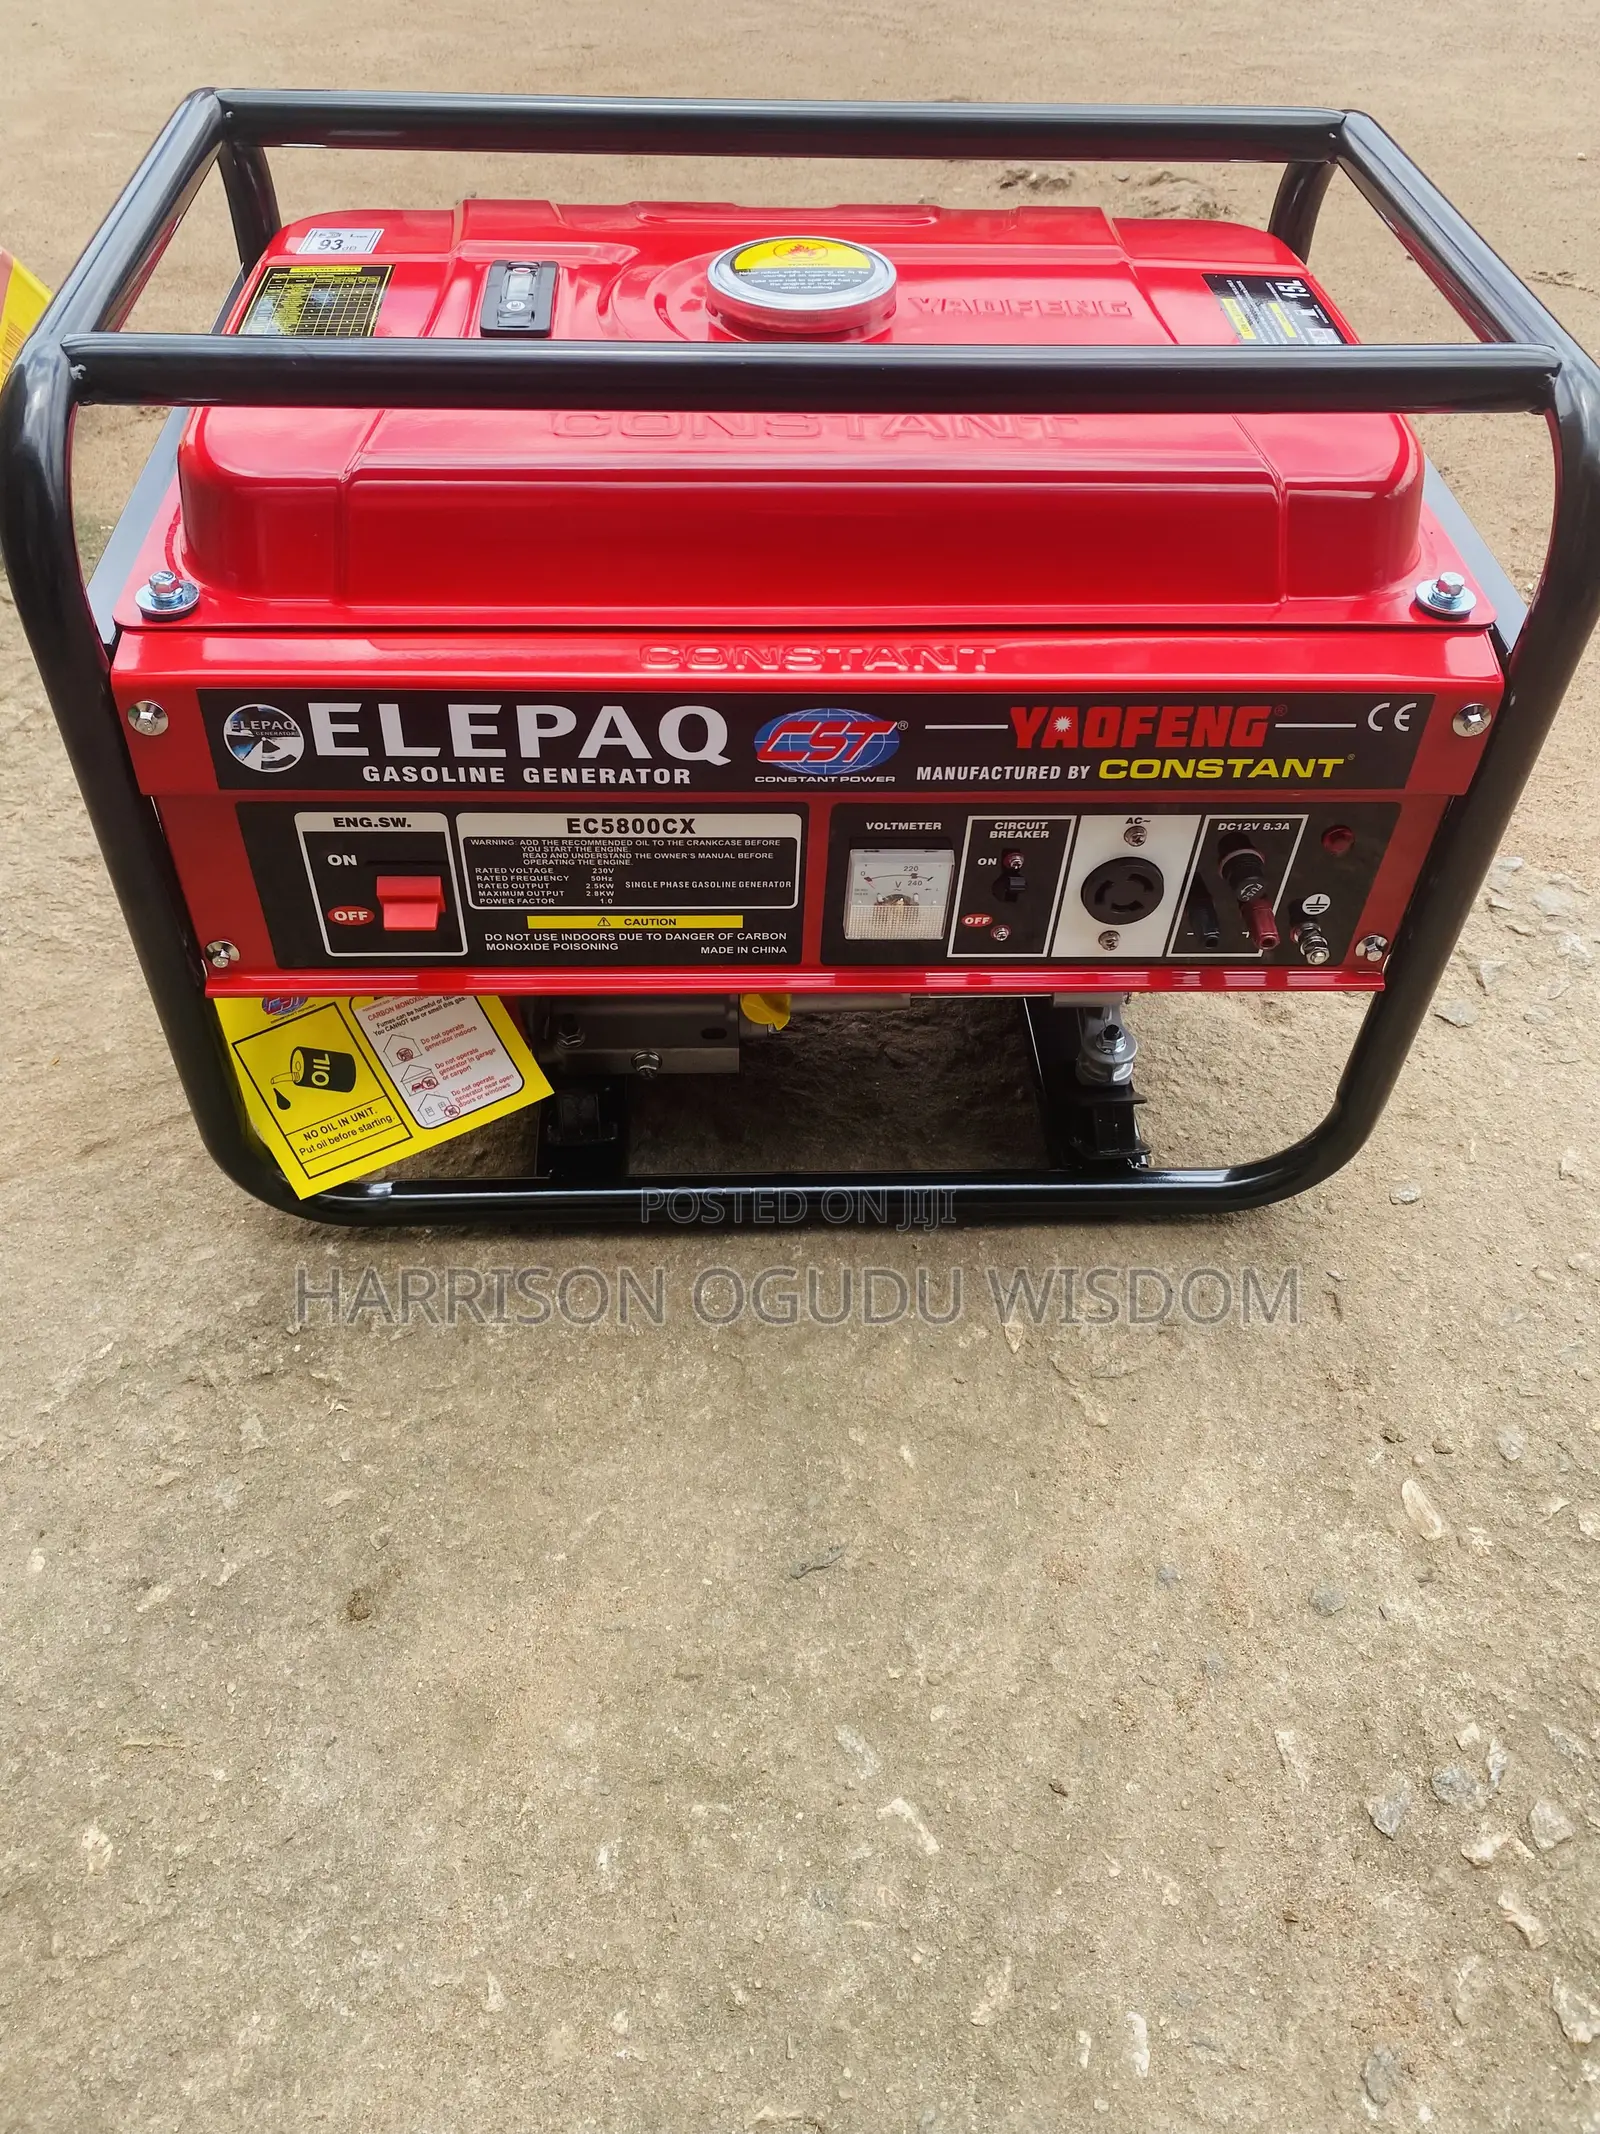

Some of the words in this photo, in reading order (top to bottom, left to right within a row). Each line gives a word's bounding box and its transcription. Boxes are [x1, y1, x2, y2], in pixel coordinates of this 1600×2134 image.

[318, 239, 343, 250] 93
[1275, 279, 1310, 299] 15L
[908, 296, 1132, 317] YAOFENG
[552, 412, 1079, 440] CONSTANT
[638, 644, 997, 673] CONSTANT
[231, 720, 297, 731] ELEPAQ
[308, 702, 732, 765] ELEPAQ
[1010, 706, 1273, 749] YAOFENG
[757, 720, 898, 763] CST
[362, 765, 505, 784] GASOLINE
[523, 767, 691, 785] GENERATOR
[916, 765, 1061, 781] MANUFACTURED
[1067, 765, 1090, 780] BY
[1099, 758, 1345, 780] CONSTANT
[333, 817, 412, 828] ENG.SW.
[566, 818, 696, 834] EC5800CX
[866, 822, 942, 830] VOLTMETER
[994, 822, 1048, 830] CIRCUIT
[1217, 822, 1260, 831] DC12V
[1263, 822, 1290, 830] 8.3A
[990, 830, 1050, 839] BREAKER
[327, 854, 358, 866] ON
[977, 858, 997, 866] ON
[334, 911, 368, 921] OFF
[624, 918, 677, 926] CAUTION
[484, 933, 502, 941] DO
[506, 933, 530, 941] NOT
[534, 933, 558, 941] USE
[562, 933, 616, 941] INDOORS
[619, 933, 642, 941] DUE
[646, 933, 662, 941] TO
[666, 933, 714, 941] DANGER
[718, 933, 734, 941] OF
[737, 933, 787, 941] CARBON
[700, 946, 734, 954] MADE
[738, 946, 748, 954] IN
[752, 946, 788, 954] CHINA
[368, 1007, 395, 1021] CARBON
[395, 996, 428, 1011] MONOXID
[373, 1028, 384, 1036] You
[385, 1018, 409, 1032] CANNOT
[410, 1014, 420, 1022] see
[428, 1004, 444, 1014] smell
[442, 1000, 454, 1008] this
[376, 1018, 396, 1028] Fumes
[396, 1012, 406, 1021] can
[414, 1001, 436, 1013] harmful
[424, 1036, 454, 1052] generator
[454, 1025, 478, 1038] indoors
[431, 1032, 441, 1040] not
[442, 1023, 464, 1036] operate
[434, 1062, 444, 1070] Do
[445, 1057, 456, 1066] not
[456, 1048, 478, 1061] operate
[438, 1060, 467, 1076] generator
[475, 1048, 496, 1060] garage
[312, 1054, 330, 1086] OIL
[455, 1086, 484, 1102] generator
[484, 1081, 498, 1090] near
[498, 1074, 514, 1084] open
[462, 1084, 472, 1092] not
[472, 1075, 495, 1088] operate
[458, 1098, 476, 1108] doors
[484, 1083, 511, 1096] windows
[303, 1130, 318, 1141] NO
[320, 1122, 338, 1134] OIL
[338, 1117, 350, 1128] IN
[350, 1107, 378, 1122] UNIT.
[299, 1144, 316, 1156] Put
[316, 1140, 328, 1150] oil
[328, 1130, 358, 1144] before
[358, 1115, 395, 1132] starting.
